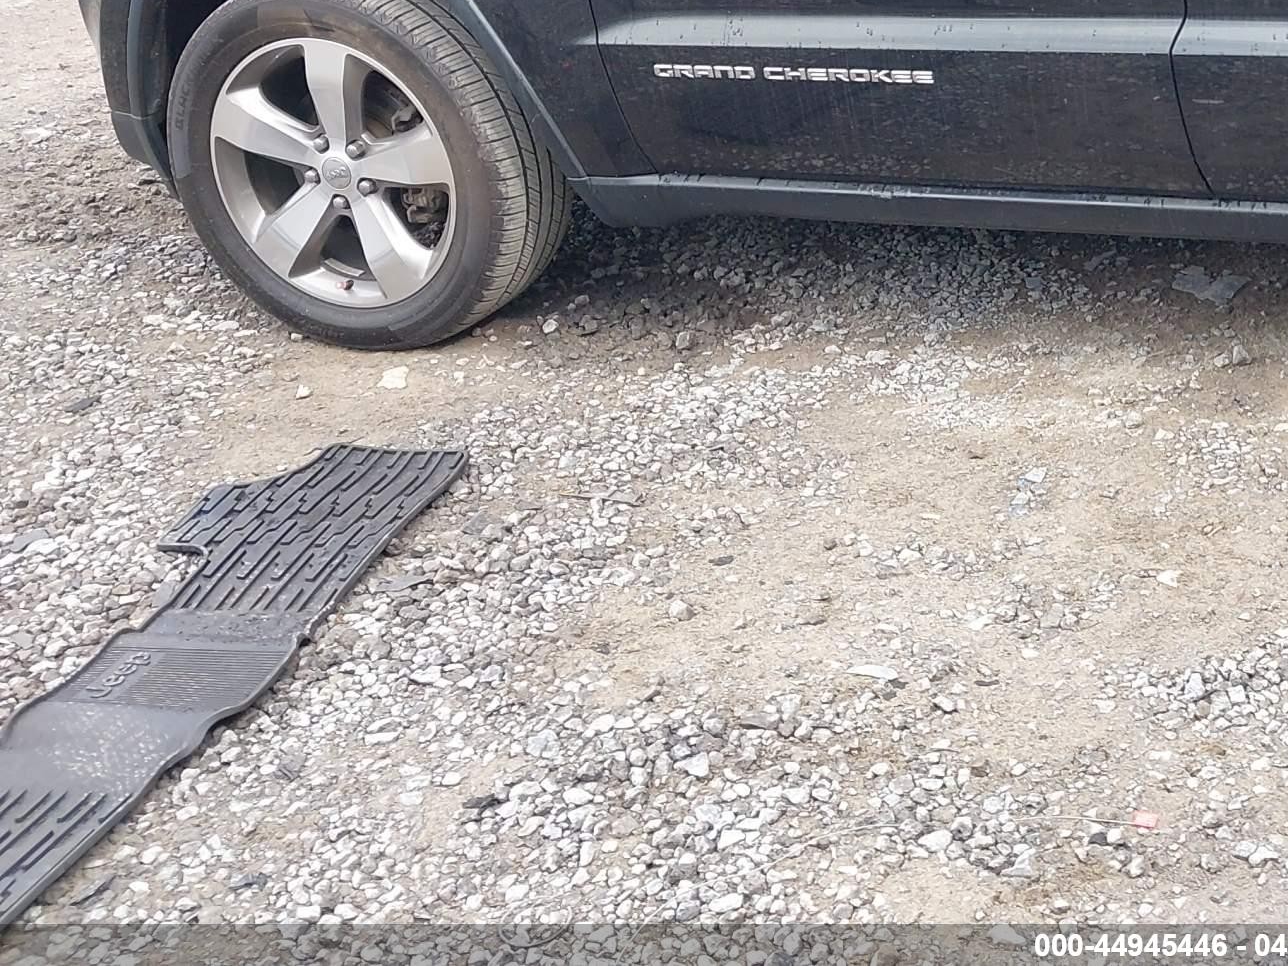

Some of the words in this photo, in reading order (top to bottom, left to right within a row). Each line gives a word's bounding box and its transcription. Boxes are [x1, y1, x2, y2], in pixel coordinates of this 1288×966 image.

[653, 64, 756, 80] GRAND
[763, 66, 935, 84] CHEROKEE
[85, 651, 152, 699] Jeep
